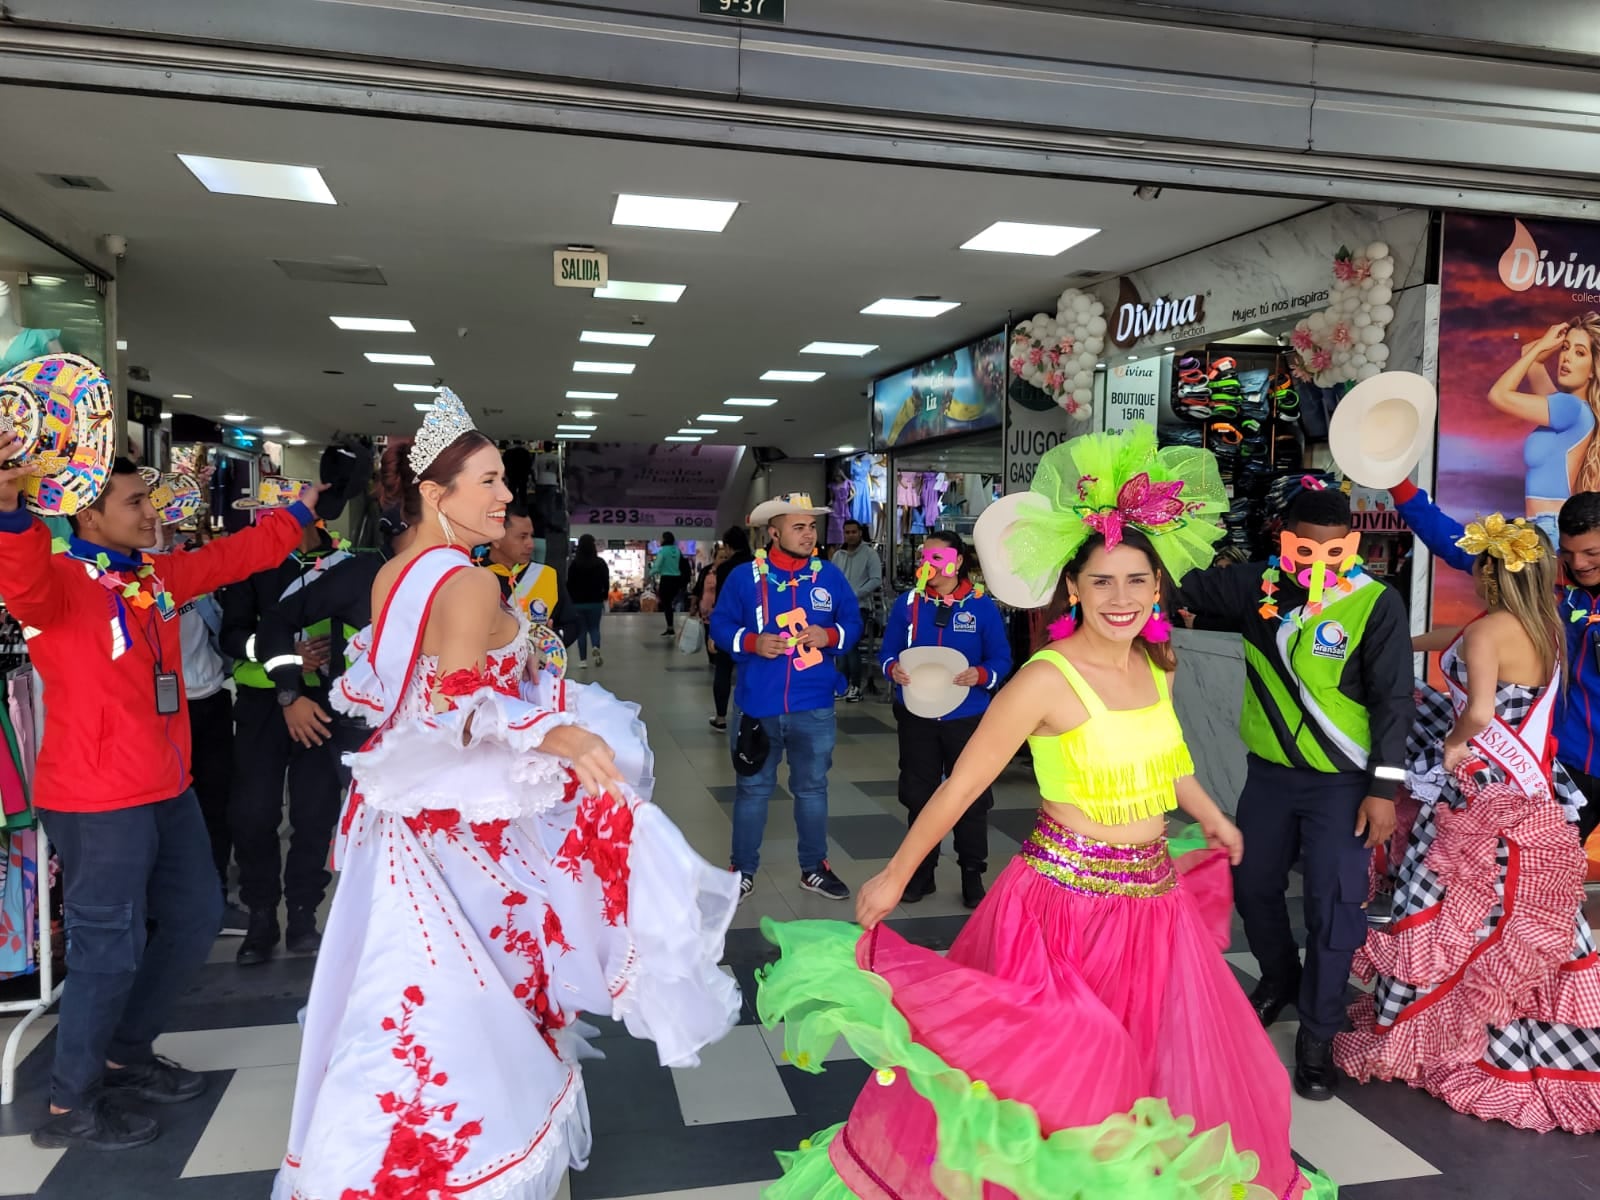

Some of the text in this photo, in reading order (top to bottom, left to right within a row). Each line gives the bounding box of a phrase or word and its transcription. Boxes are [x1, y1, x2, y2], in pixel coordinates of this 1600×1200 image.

[561, 257, 601, 281] SALIDA
[1509, 247, 1600, 291] Divin
[1232, 291, 1330, 322] Mujer, tú nos inspiras
[1571, 291, 1600, 304] collec
[1116, 294, 1198, 342] Divina
[1171, 325, 1206, 341] collection
[1111, 391, 1157, 406] BOUTIQUE
[588, 509, 641, 524] 2293
